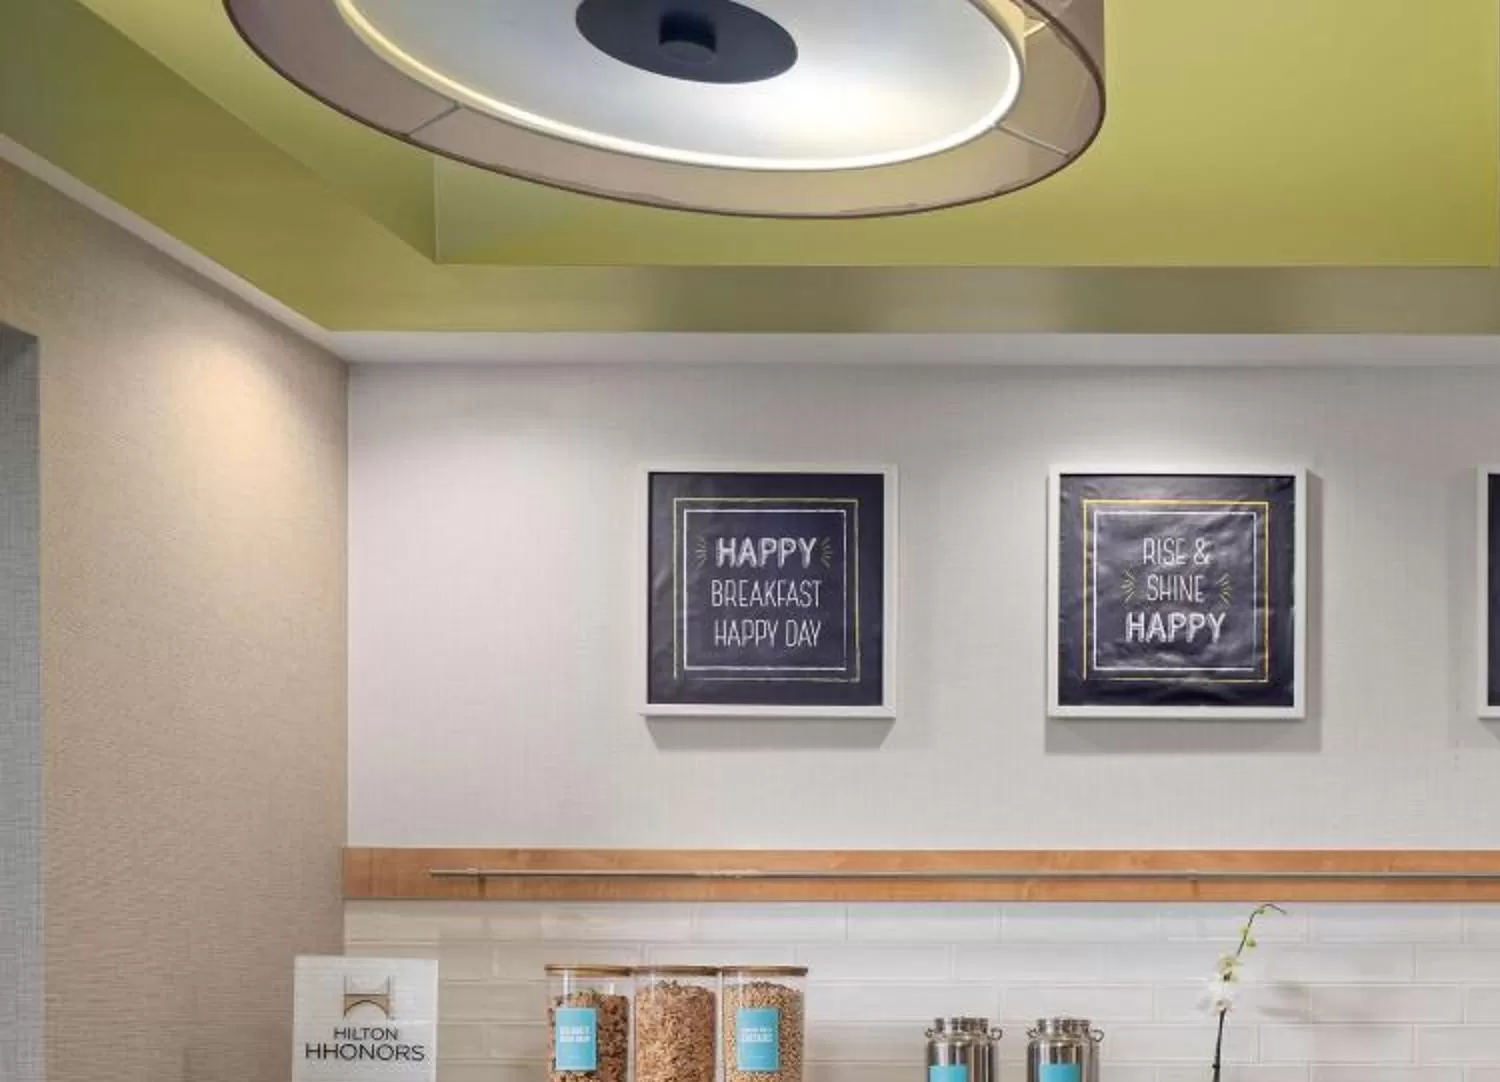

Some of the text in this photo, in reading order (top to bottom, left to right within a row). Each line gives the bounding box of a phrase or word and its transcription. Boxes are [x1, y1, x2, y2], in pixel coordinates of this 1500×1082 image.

[715, 536, 817, 569] HAPPY
[1142, 536, 1213, 566] RISE &
[711, 579, 822, 608] BREAKFAST
[1146, 574, 1205, 603] SHINE
[714, 619, 822, 648] HAPPY DAY
[1125, 611, 1227, 644] HAPPY
[333, 1027, 399, 1041] HILTON
[305, 1043, 425, 1061] HHONORS
